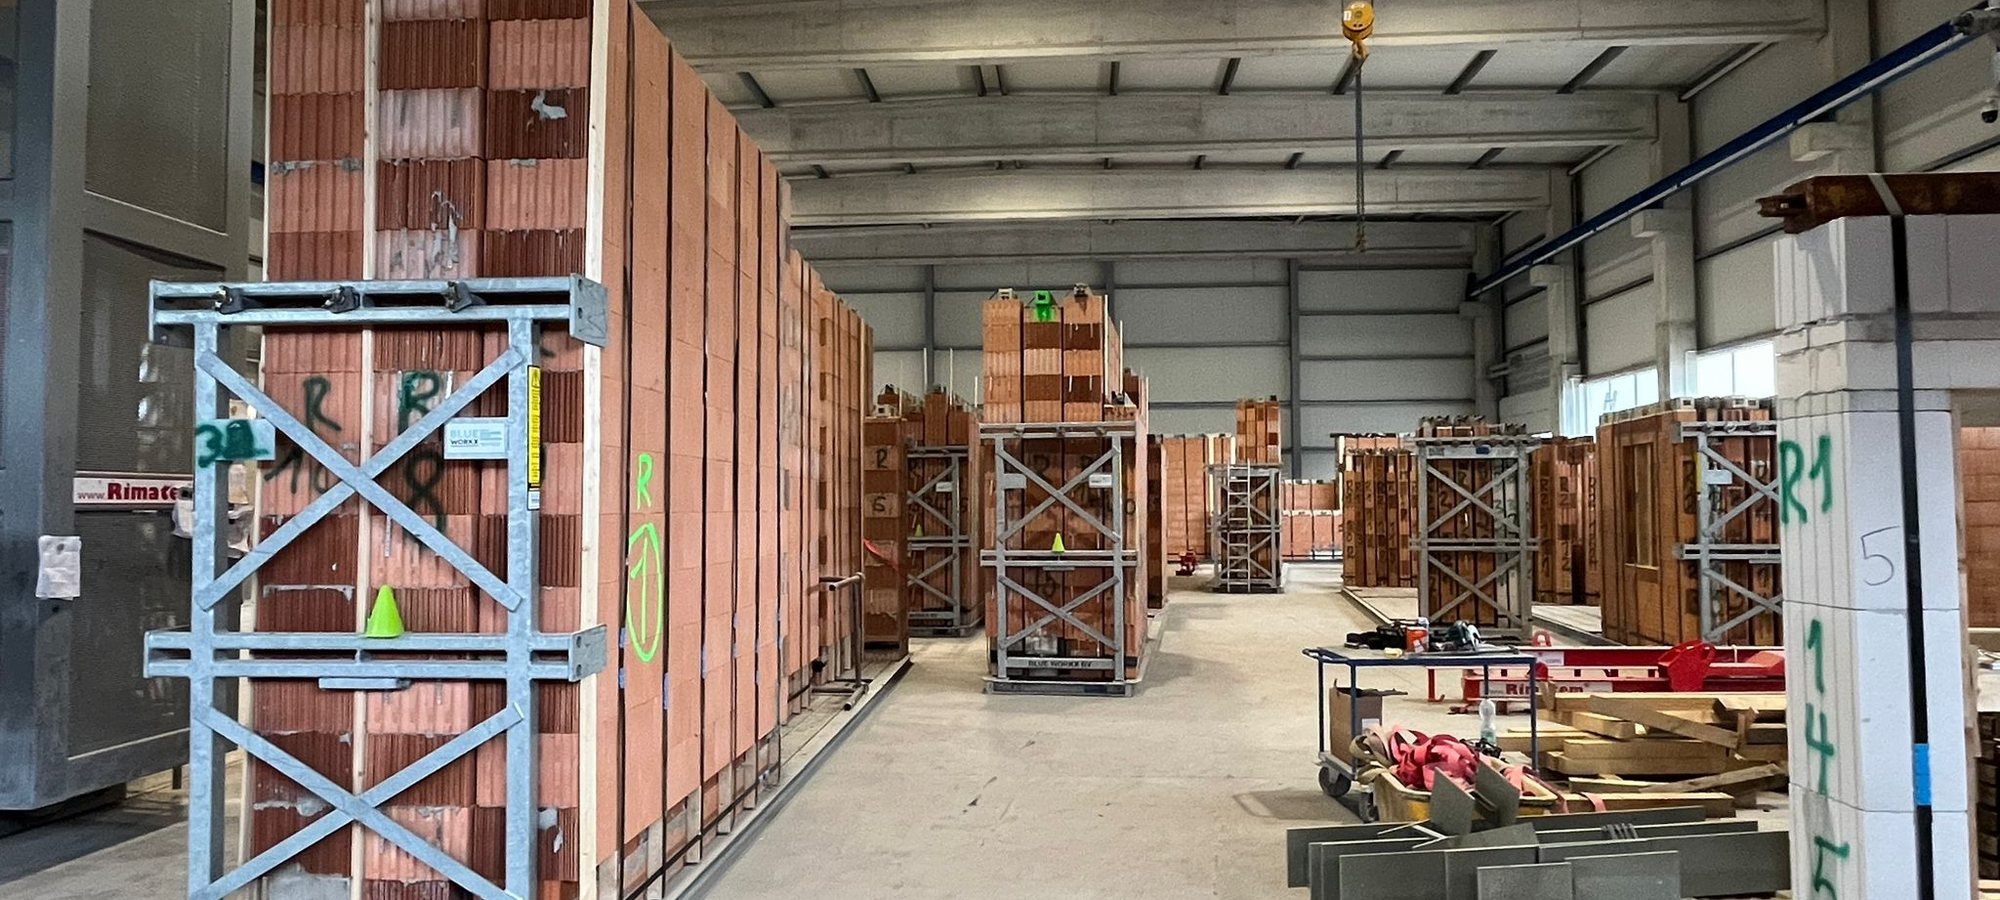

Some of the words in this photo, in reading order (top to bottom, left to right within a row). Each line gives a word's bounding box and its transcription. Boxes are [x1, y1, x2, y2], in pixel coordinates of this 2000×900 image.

[302, 375, 342, 434] R
[399, 371, 440, 436] R
[450, 429, 478, 438] BLUE
[636, 453, 654, 511] R
[1779, 434, 1833, 525] R1
[1861, 525, 1901, 586] 5
[1505, 683, 1583, 695] Rimem
